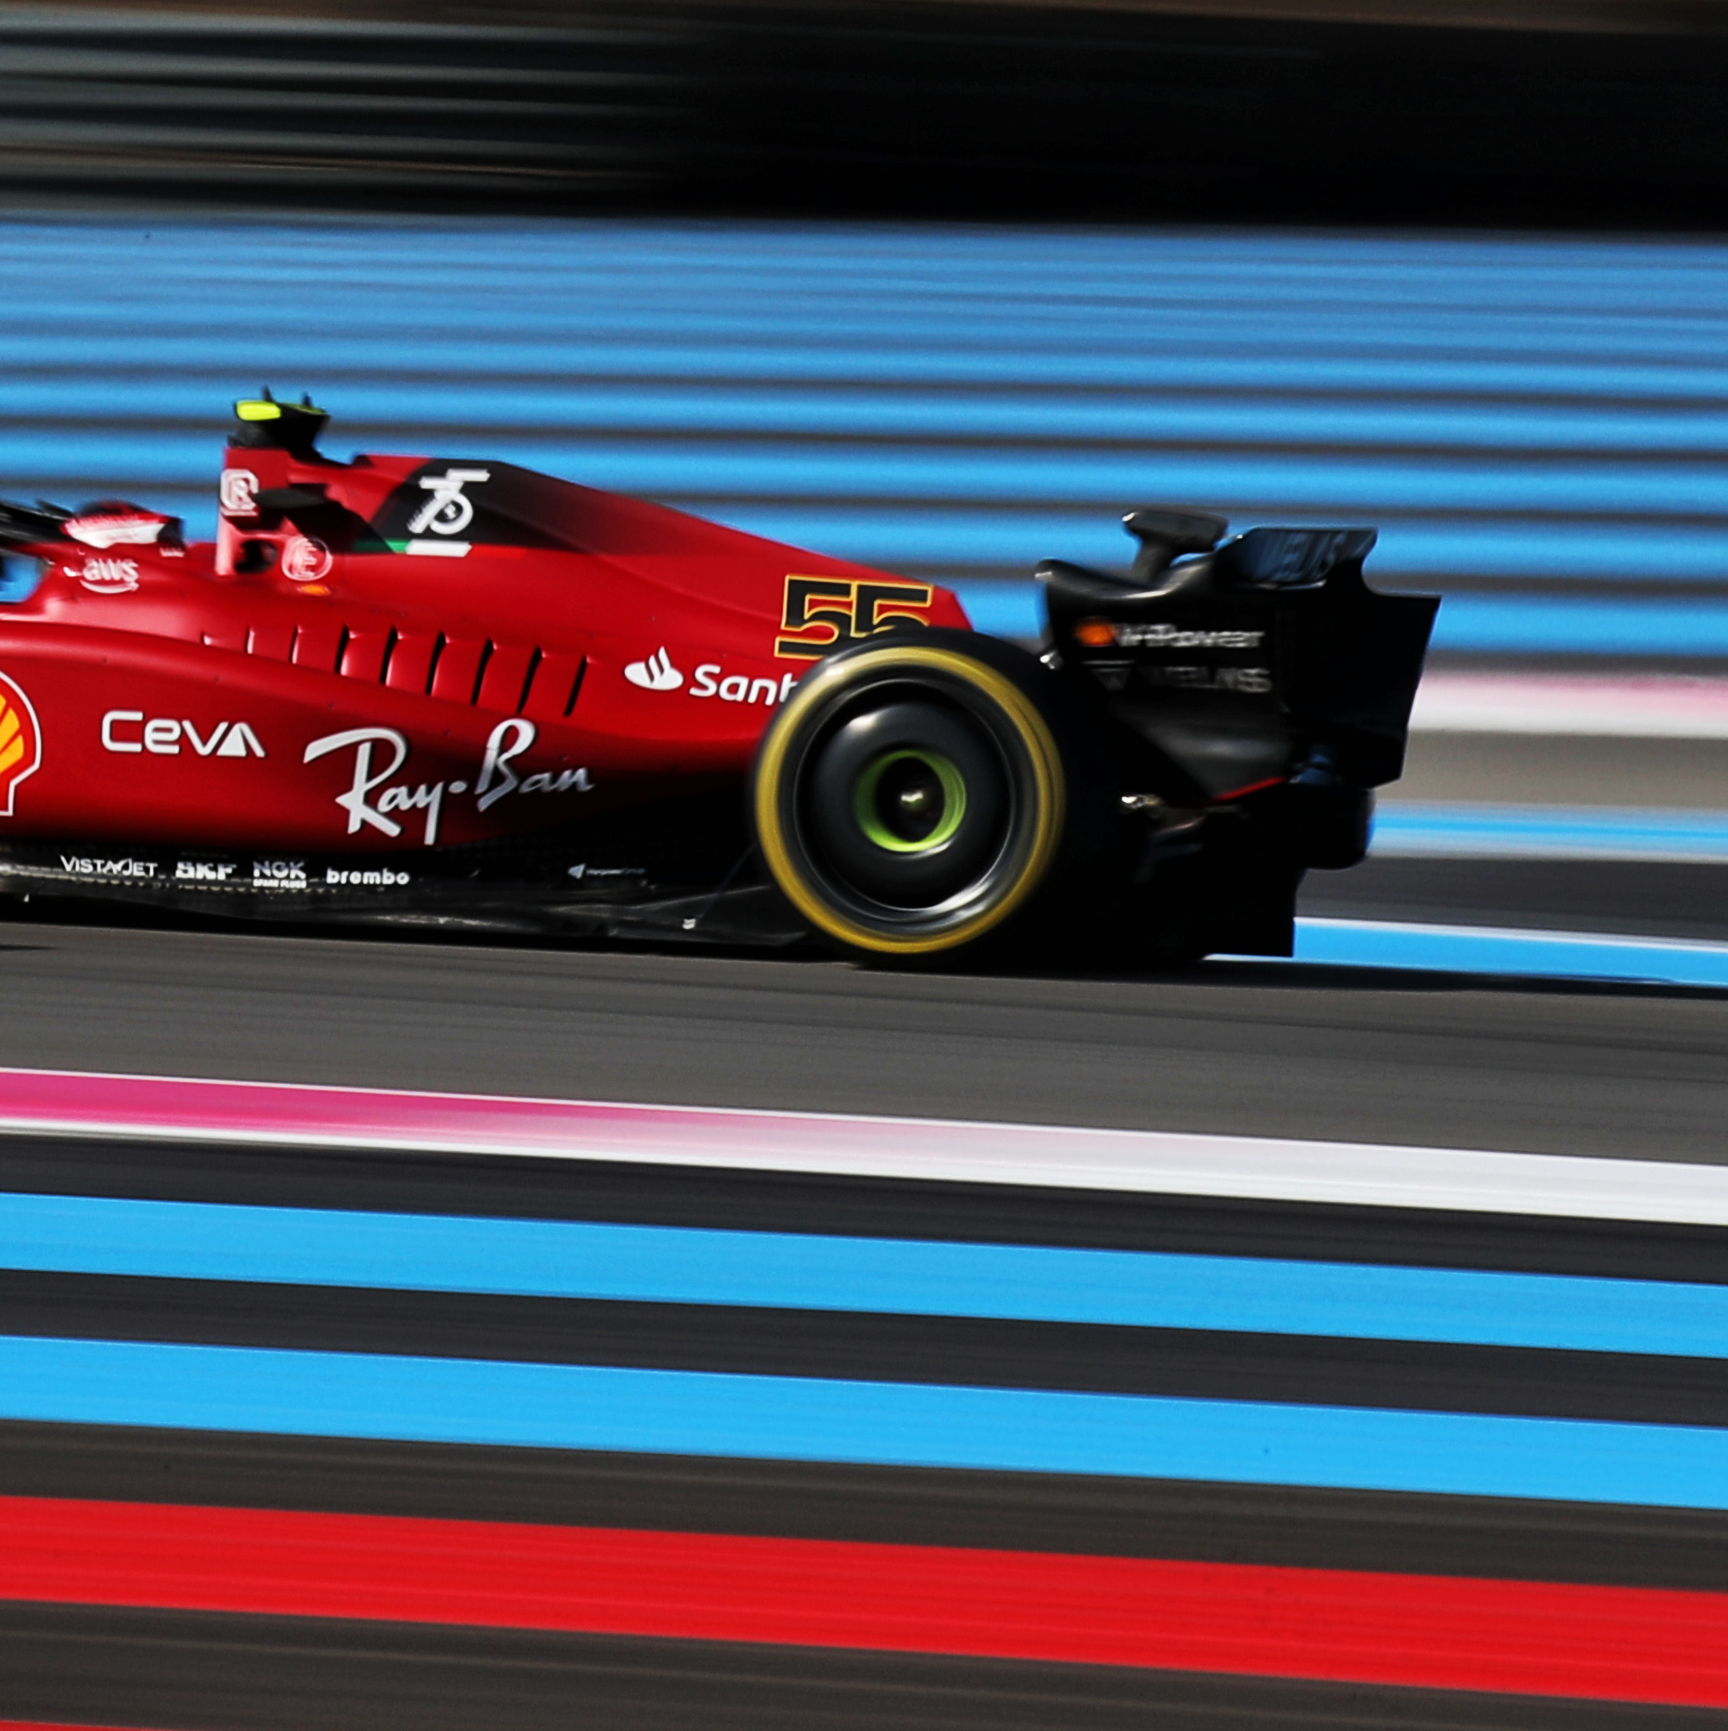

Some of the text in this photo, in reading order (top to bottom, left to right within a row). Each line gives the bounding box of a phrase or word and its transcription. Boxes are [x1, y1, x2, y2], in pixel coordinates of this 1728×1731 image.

[774, 574, 934, 661] 55
[253, 860, 307, 879] NGK
[325, 866, 411, 886] brembo
